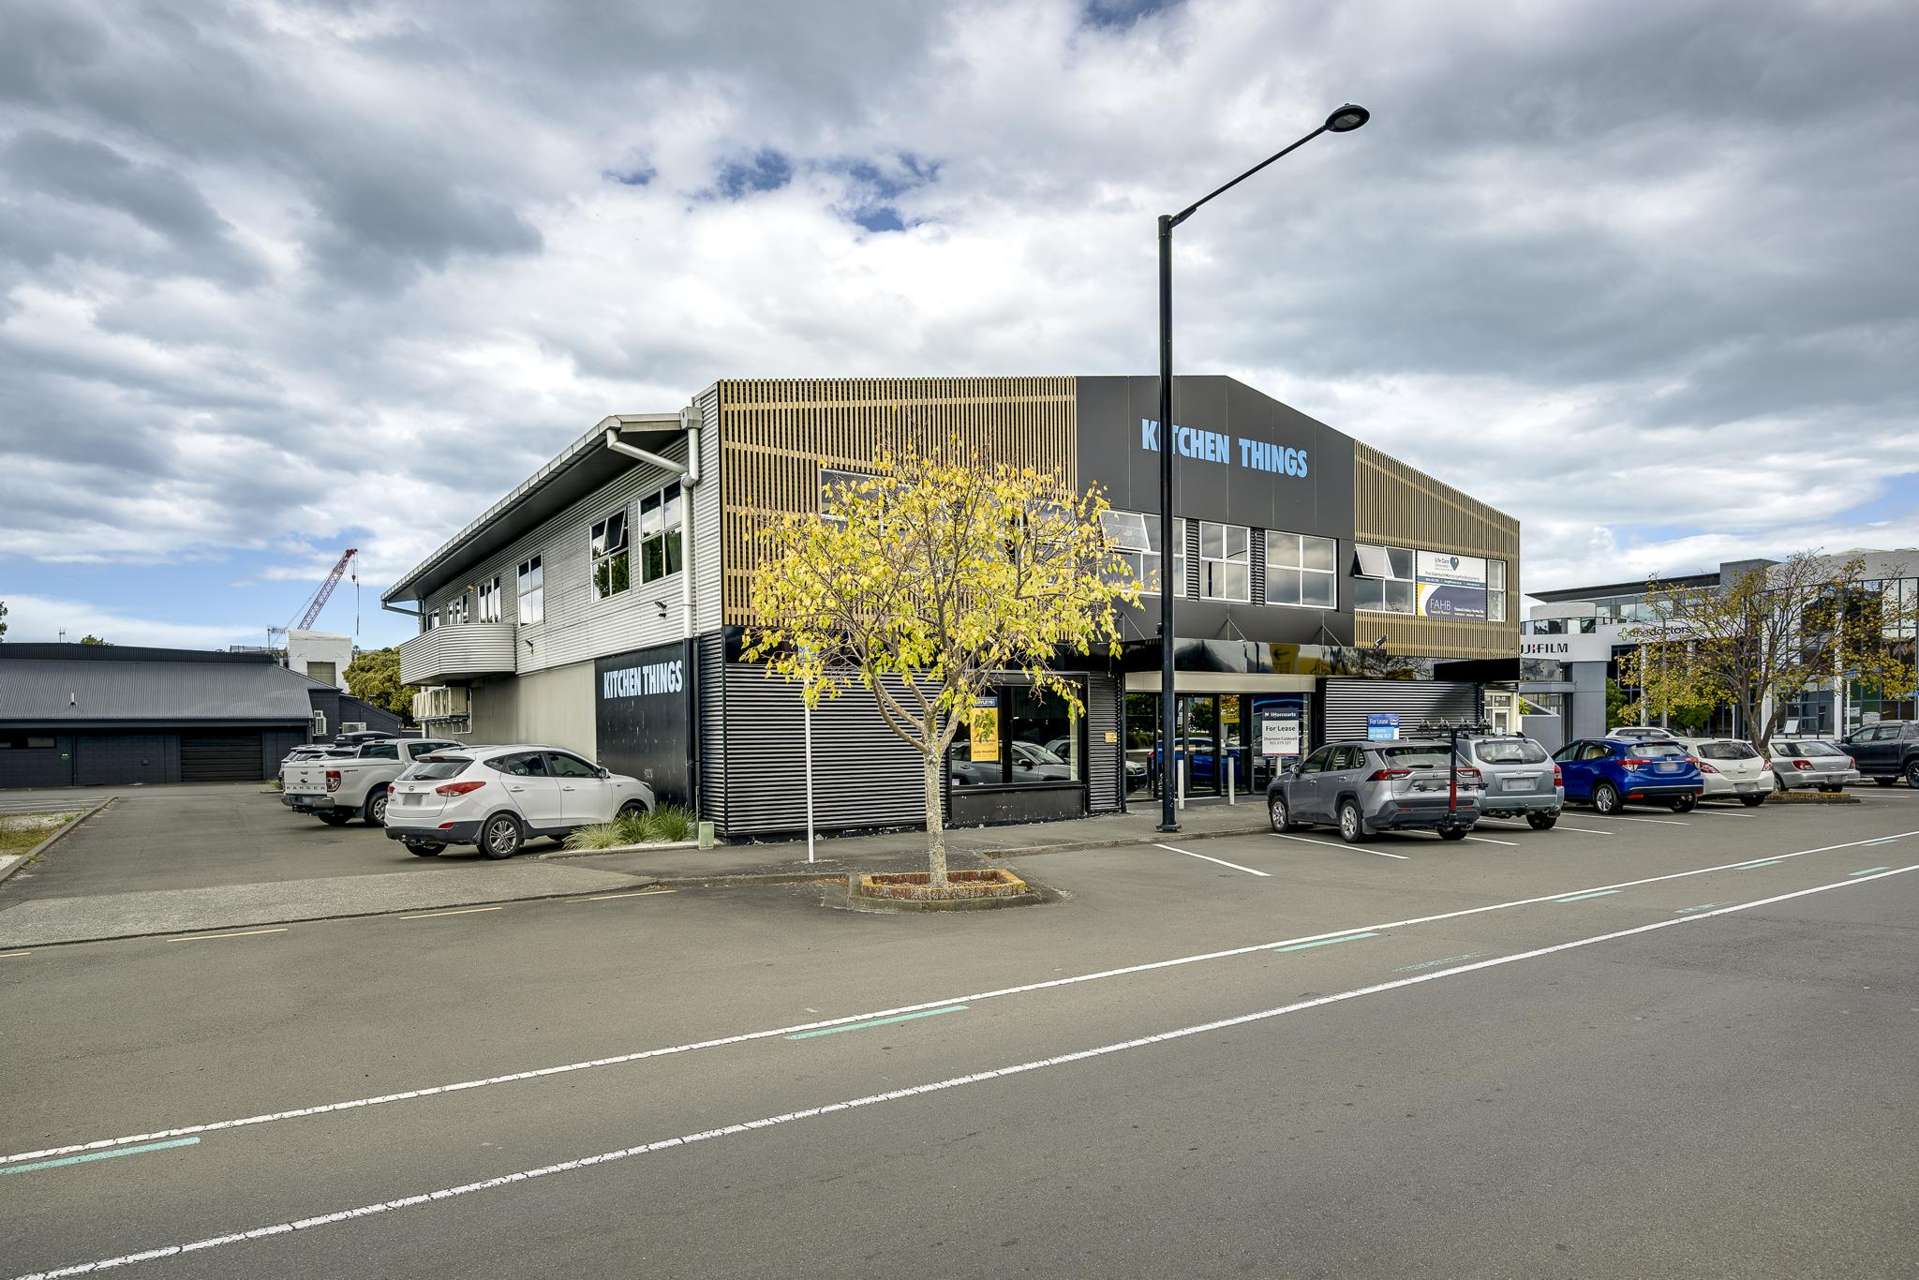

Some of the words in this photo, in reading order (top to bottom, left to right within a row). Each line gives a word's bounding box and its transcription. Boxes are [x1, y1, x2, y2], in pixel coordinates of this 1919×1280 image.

[1238, 438, 1308, 478] THINGS
[1520, 643, 1568, 655] JIFILM
[604, 667, 641, 699] KITCHEN
[642, 660, 682, 695] THINGS
